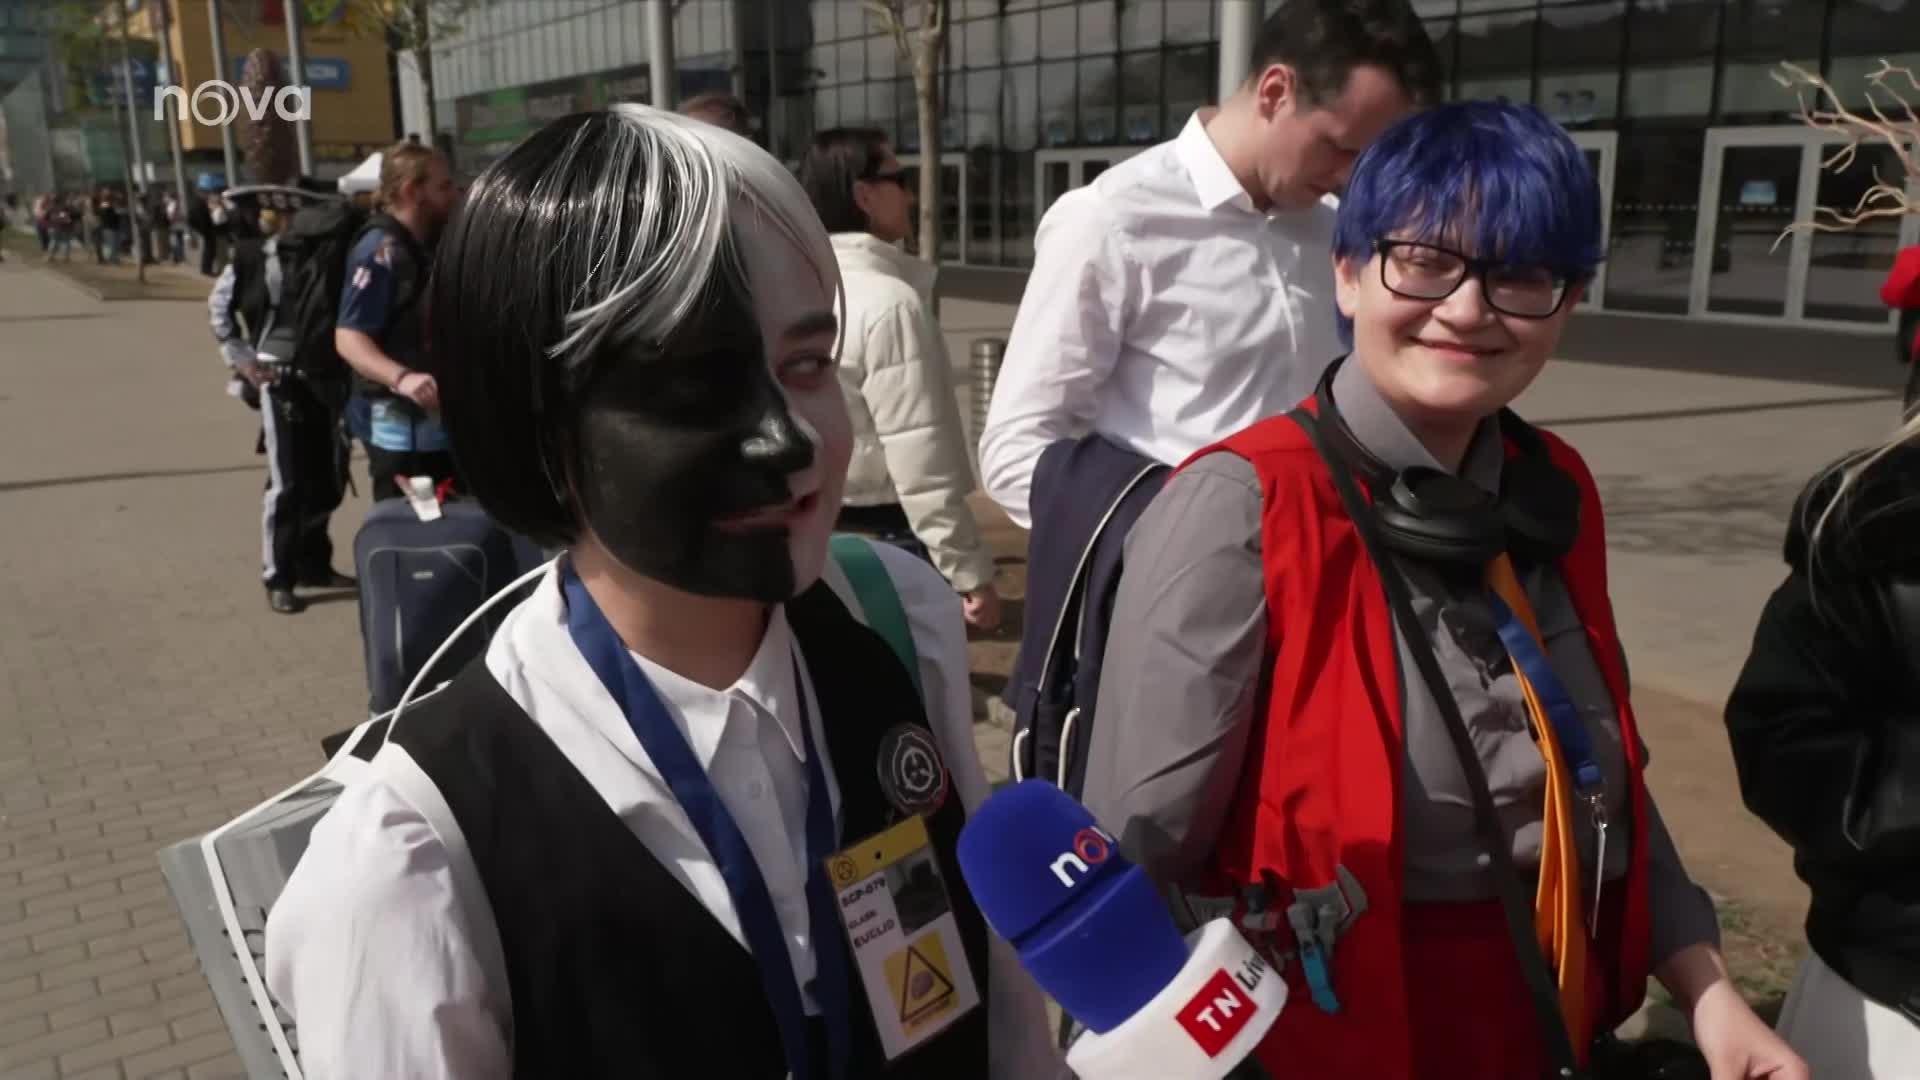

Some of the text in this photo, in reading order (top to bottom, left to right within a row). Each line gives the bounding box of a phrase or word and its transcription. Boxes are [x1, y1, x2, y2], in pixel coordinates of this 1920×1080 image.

[853, 918, 895, 949] EUCLID
[1195, 951, 1265, 1032] TN Liv
